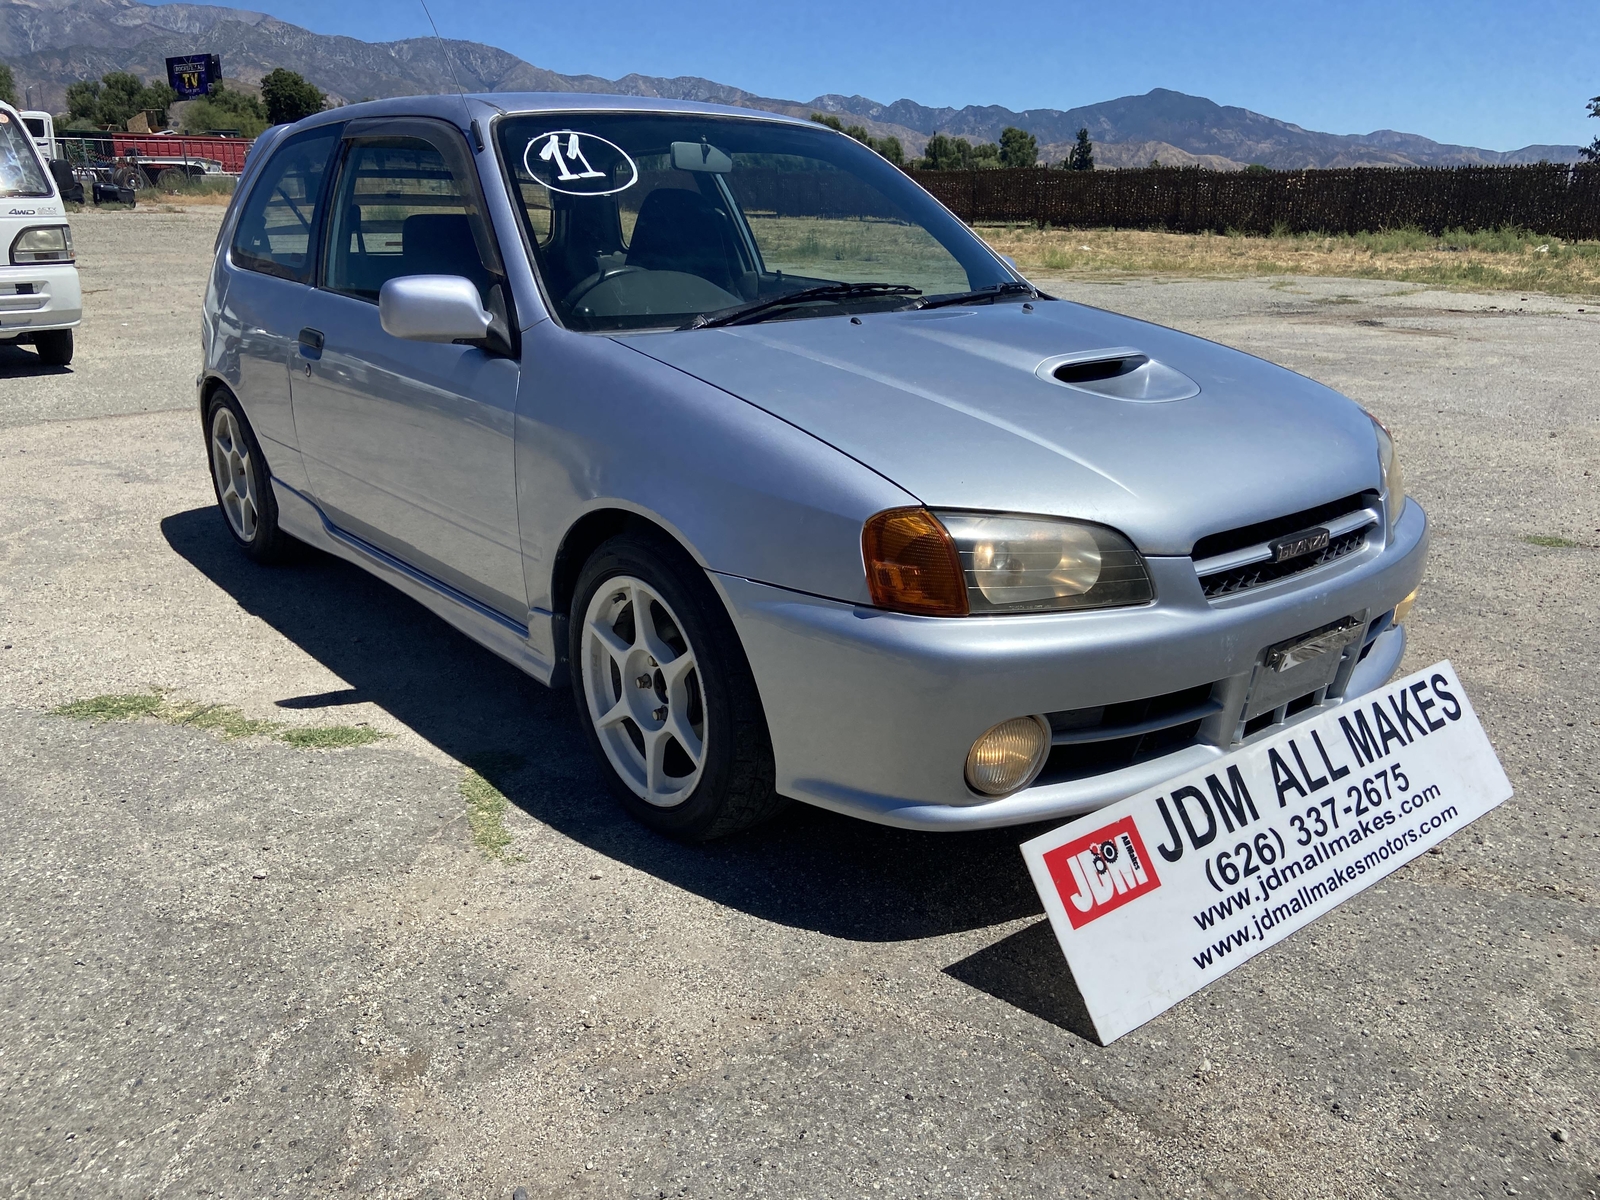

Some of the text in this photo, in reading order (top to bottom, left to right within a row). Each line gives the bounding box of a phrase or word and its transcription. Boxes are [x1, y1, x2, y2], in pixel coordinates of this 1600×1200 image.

[182, 72, 199, 89] TV
[539, 133, 606, 180] 11
[1155, 673, 1462, 862] JDM ALL MAKES
[1205, 763, 1410, 892] (626) 337-2675
[1066, 832, 1148, 912] JDM
[1192, 806, 1459, 970] www.jdmallmakesmotors.com
[1193, 785, 1441, 931] www.jdmallmakes.com
